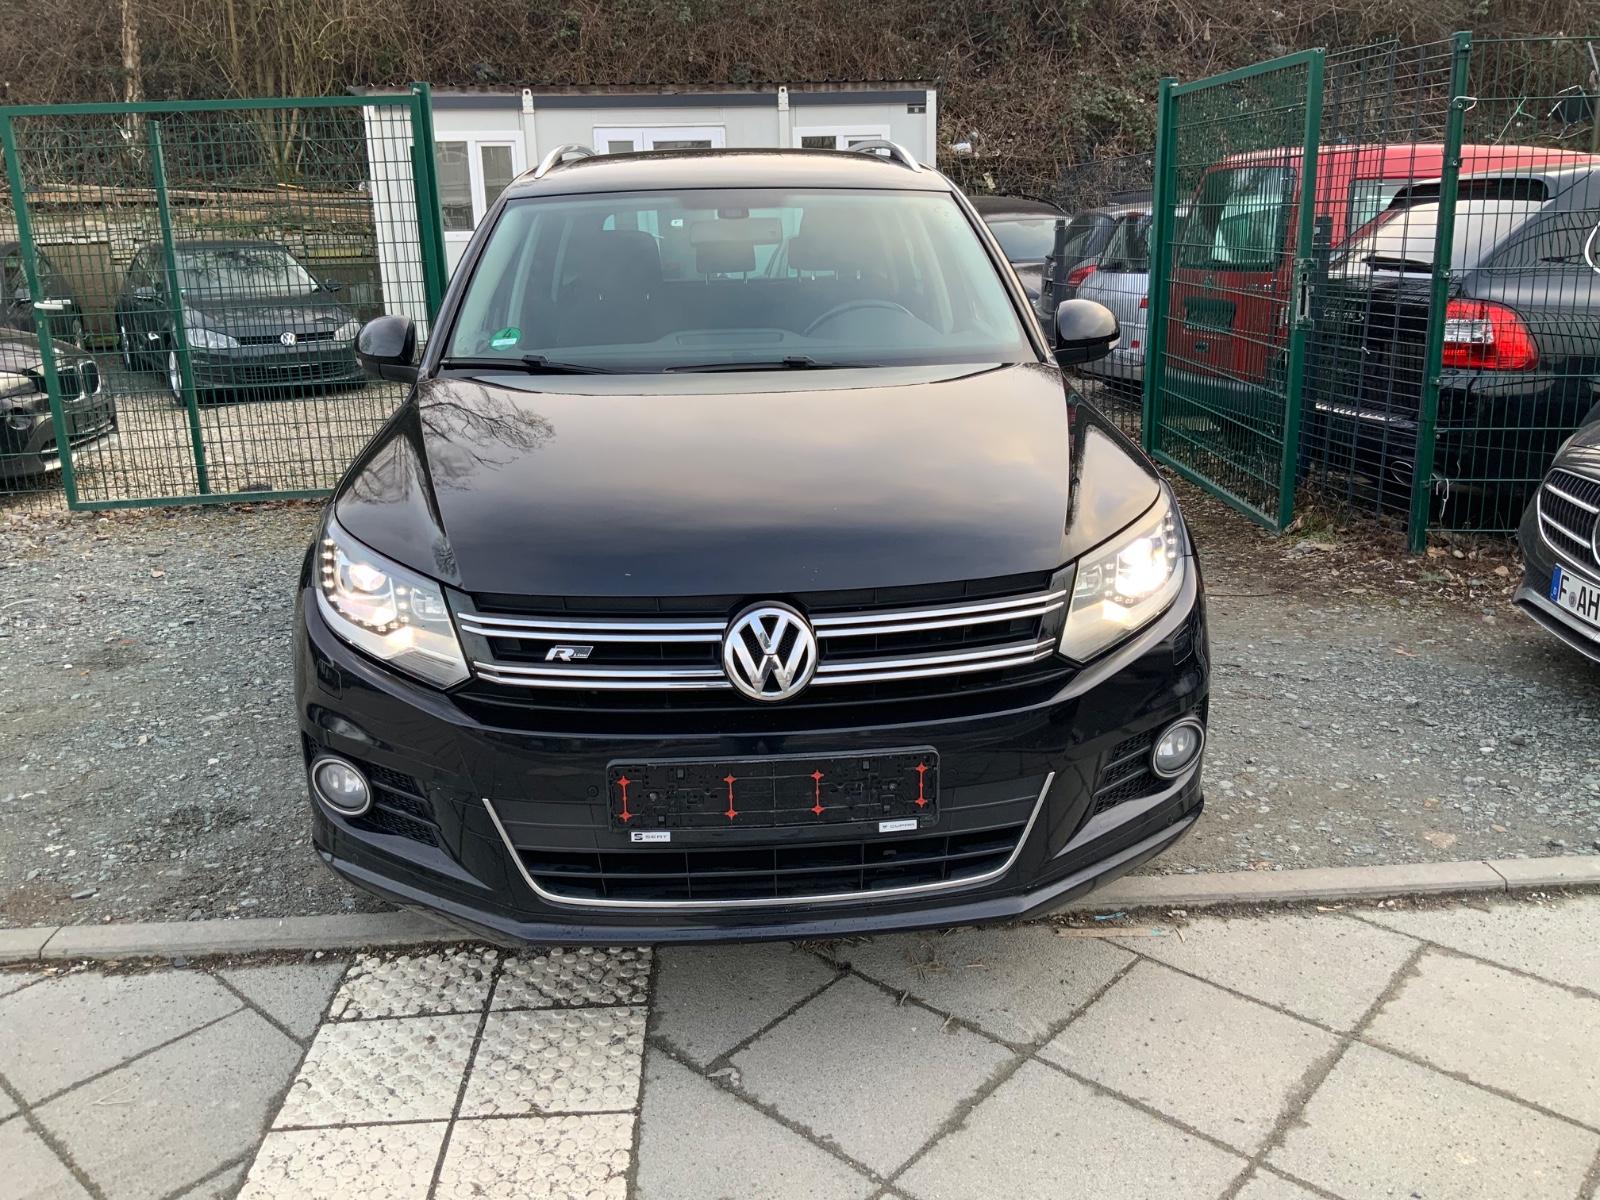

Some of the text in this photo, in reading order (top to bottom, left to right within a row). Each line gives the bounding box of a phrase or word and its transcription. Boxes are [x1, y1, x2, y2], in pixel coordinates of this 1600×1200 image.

[503, 328, 512, 338] 4
[1559, 574, 1600, 621] F AH
[545, 647, 575, 661] R
[724, 606, 818, 701] VW
